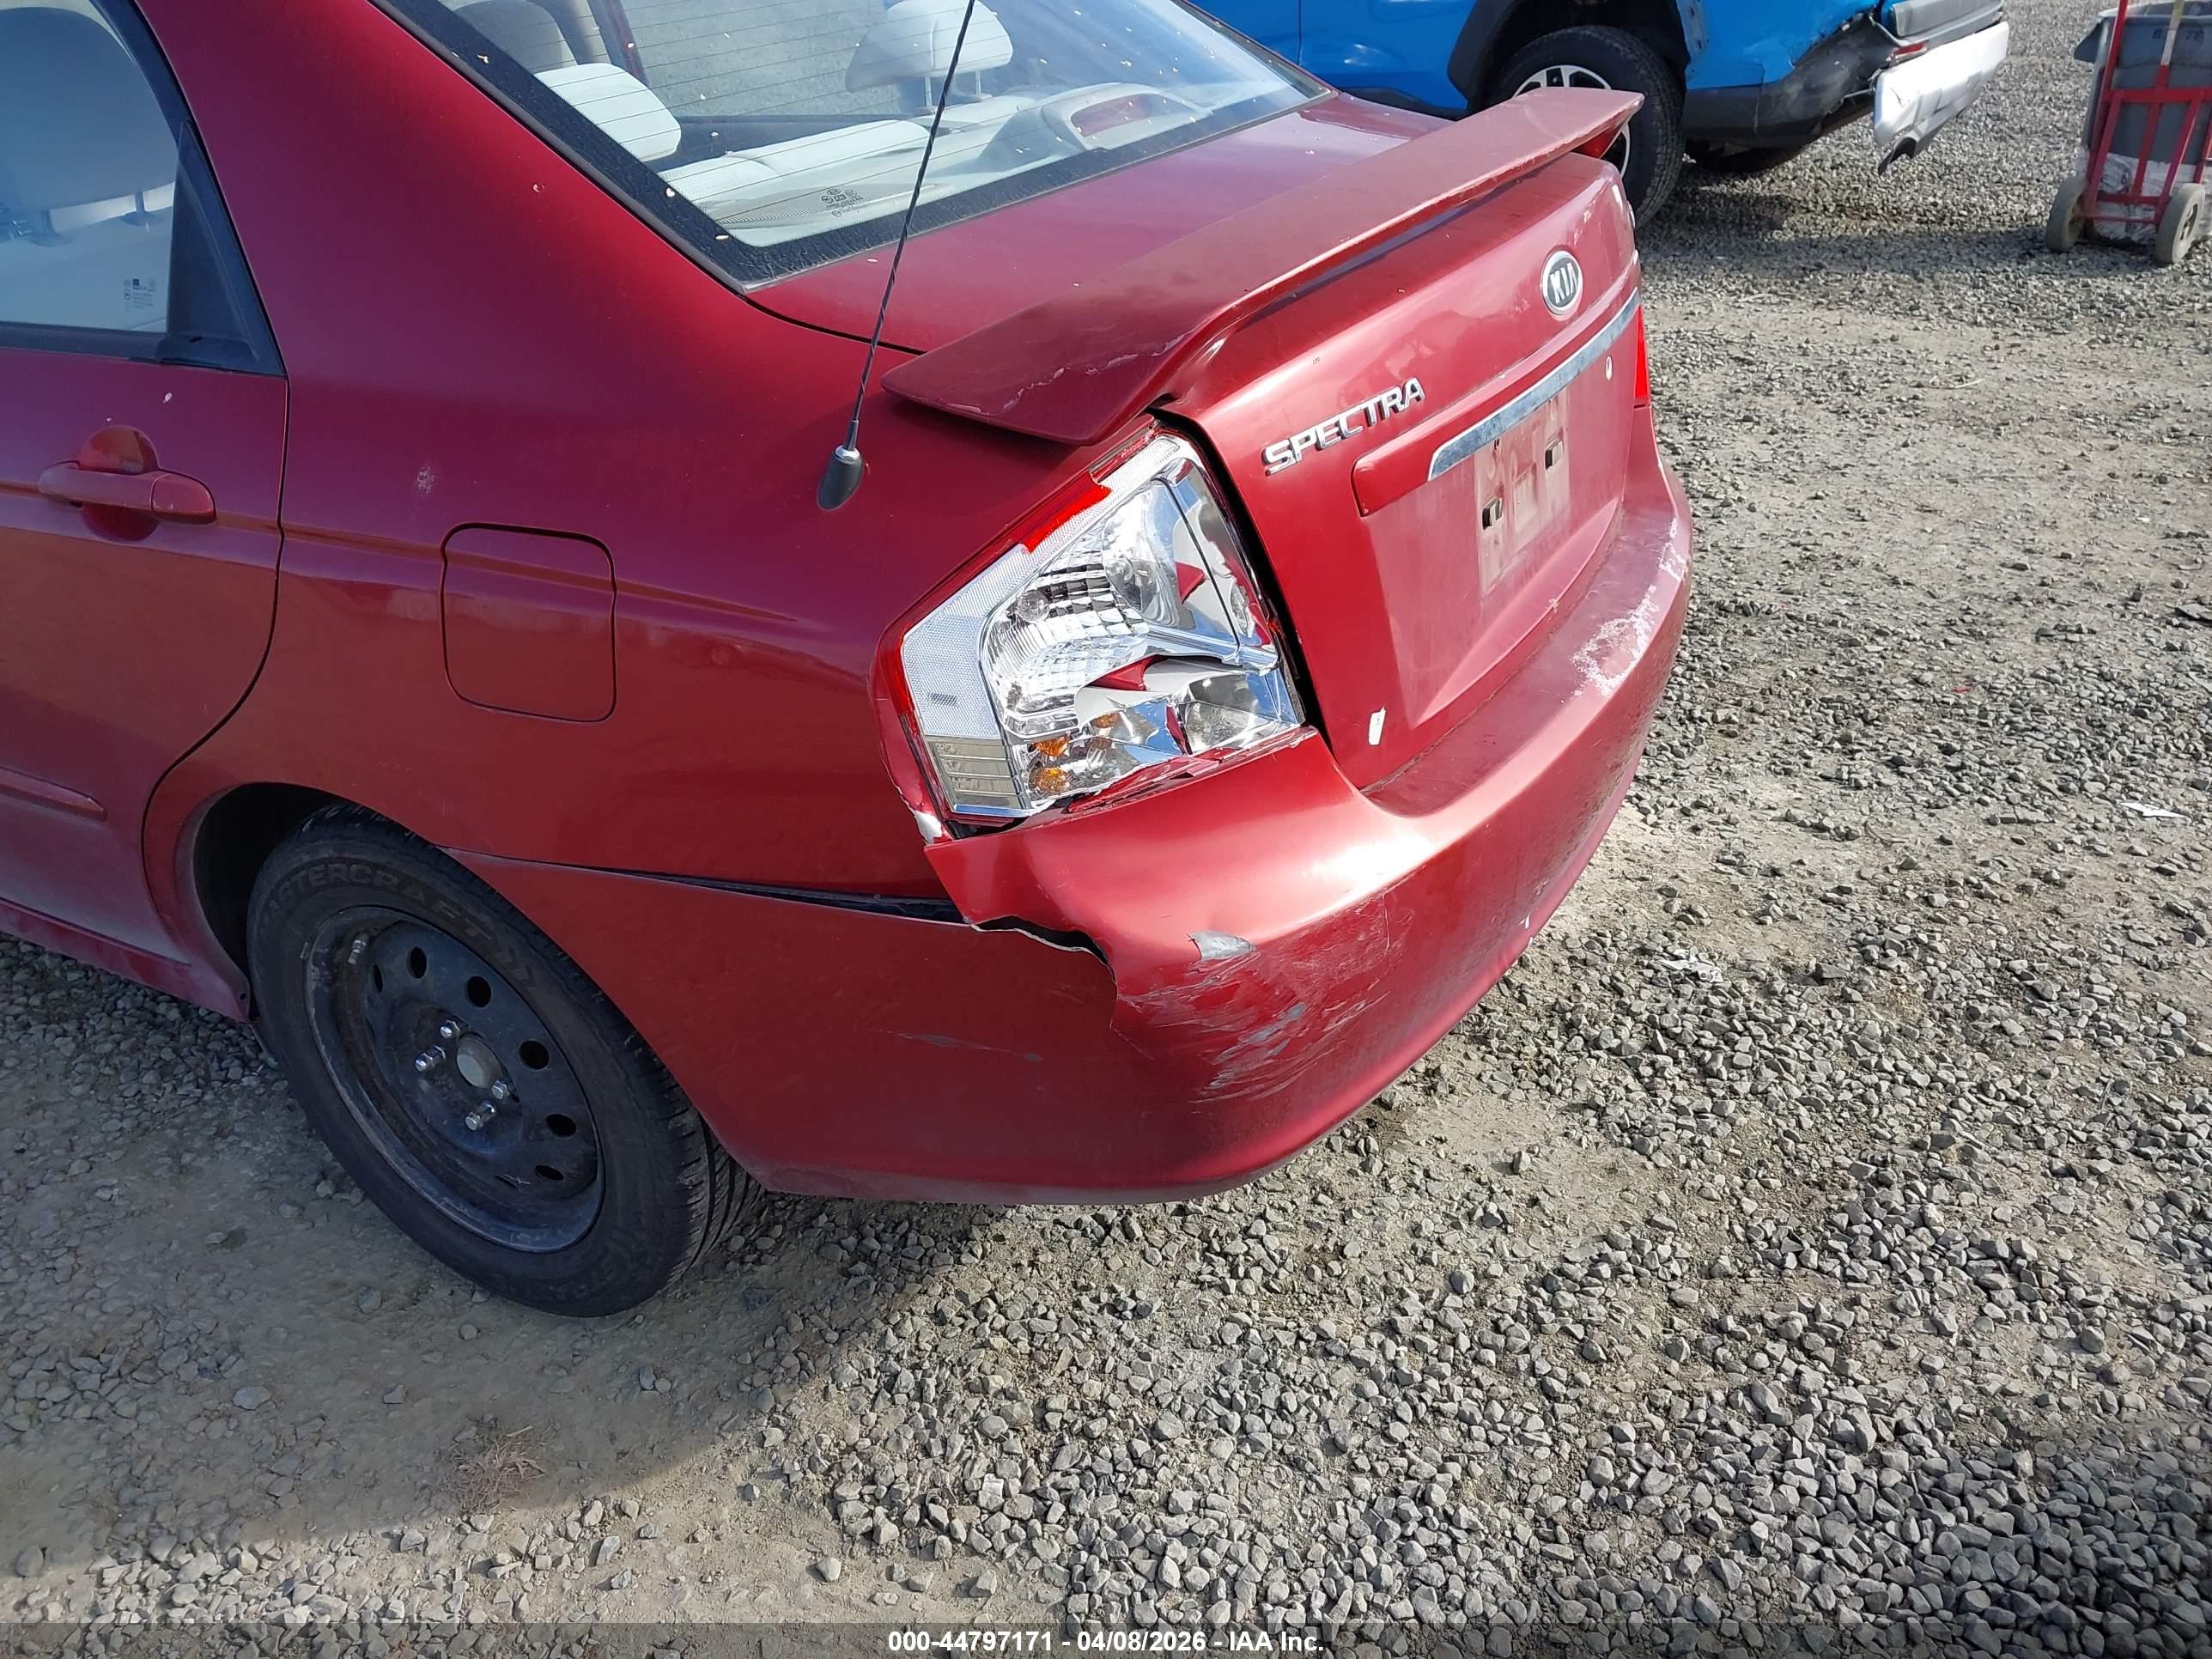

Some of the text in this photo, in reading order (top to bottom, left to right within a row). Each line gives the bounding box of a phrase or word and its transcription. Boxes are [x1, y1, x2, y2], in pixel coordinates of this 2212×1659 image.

[1549, 262, 1578, 304] KIA
[1262, 377, 1425, 477] SPECTRA
[260, 862, 492, 941] STERCRAFT
